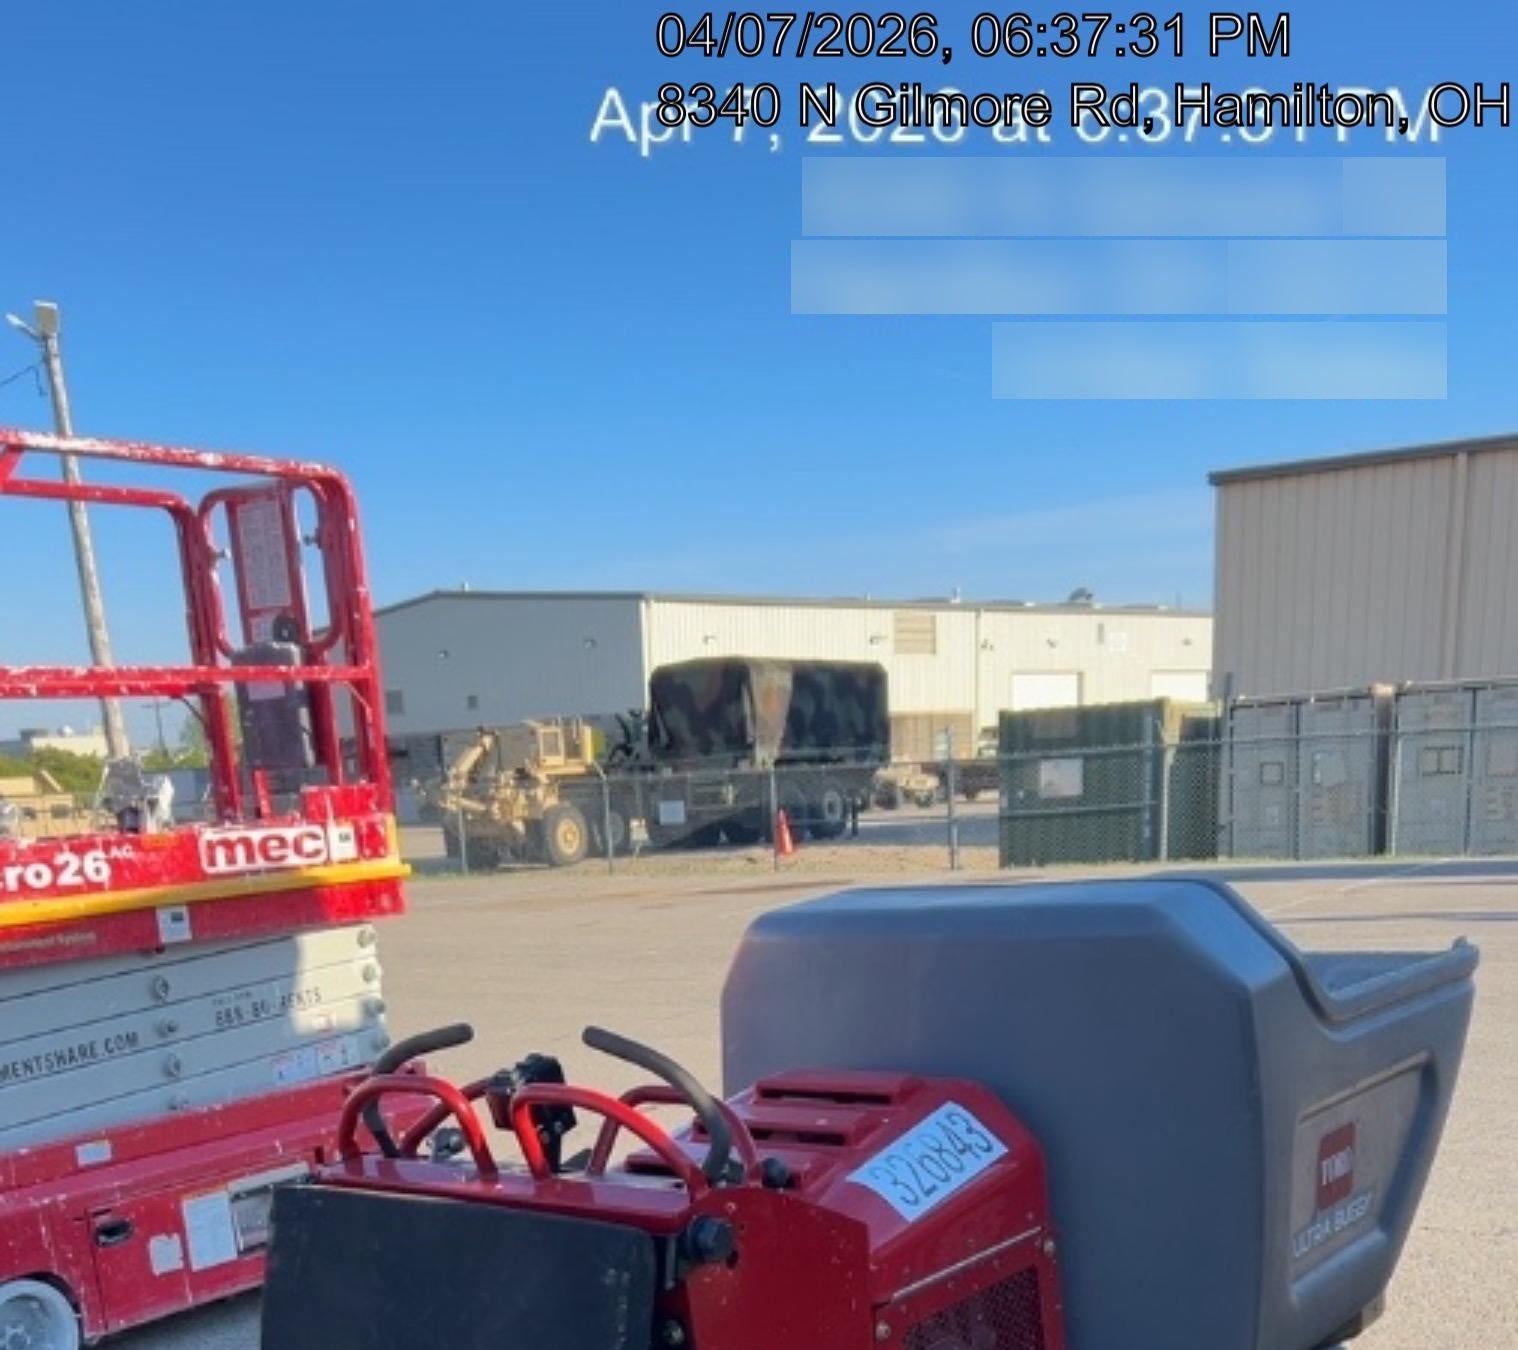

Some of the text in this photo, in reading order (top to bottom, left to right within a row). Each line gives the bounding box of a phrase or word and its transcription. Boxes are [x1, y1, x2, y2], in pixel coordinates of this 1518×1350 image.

[205, 830, 323, 869] mec
[0, 850, 112, 892] ro26
[869, 1111, 994, 1207] 326843
